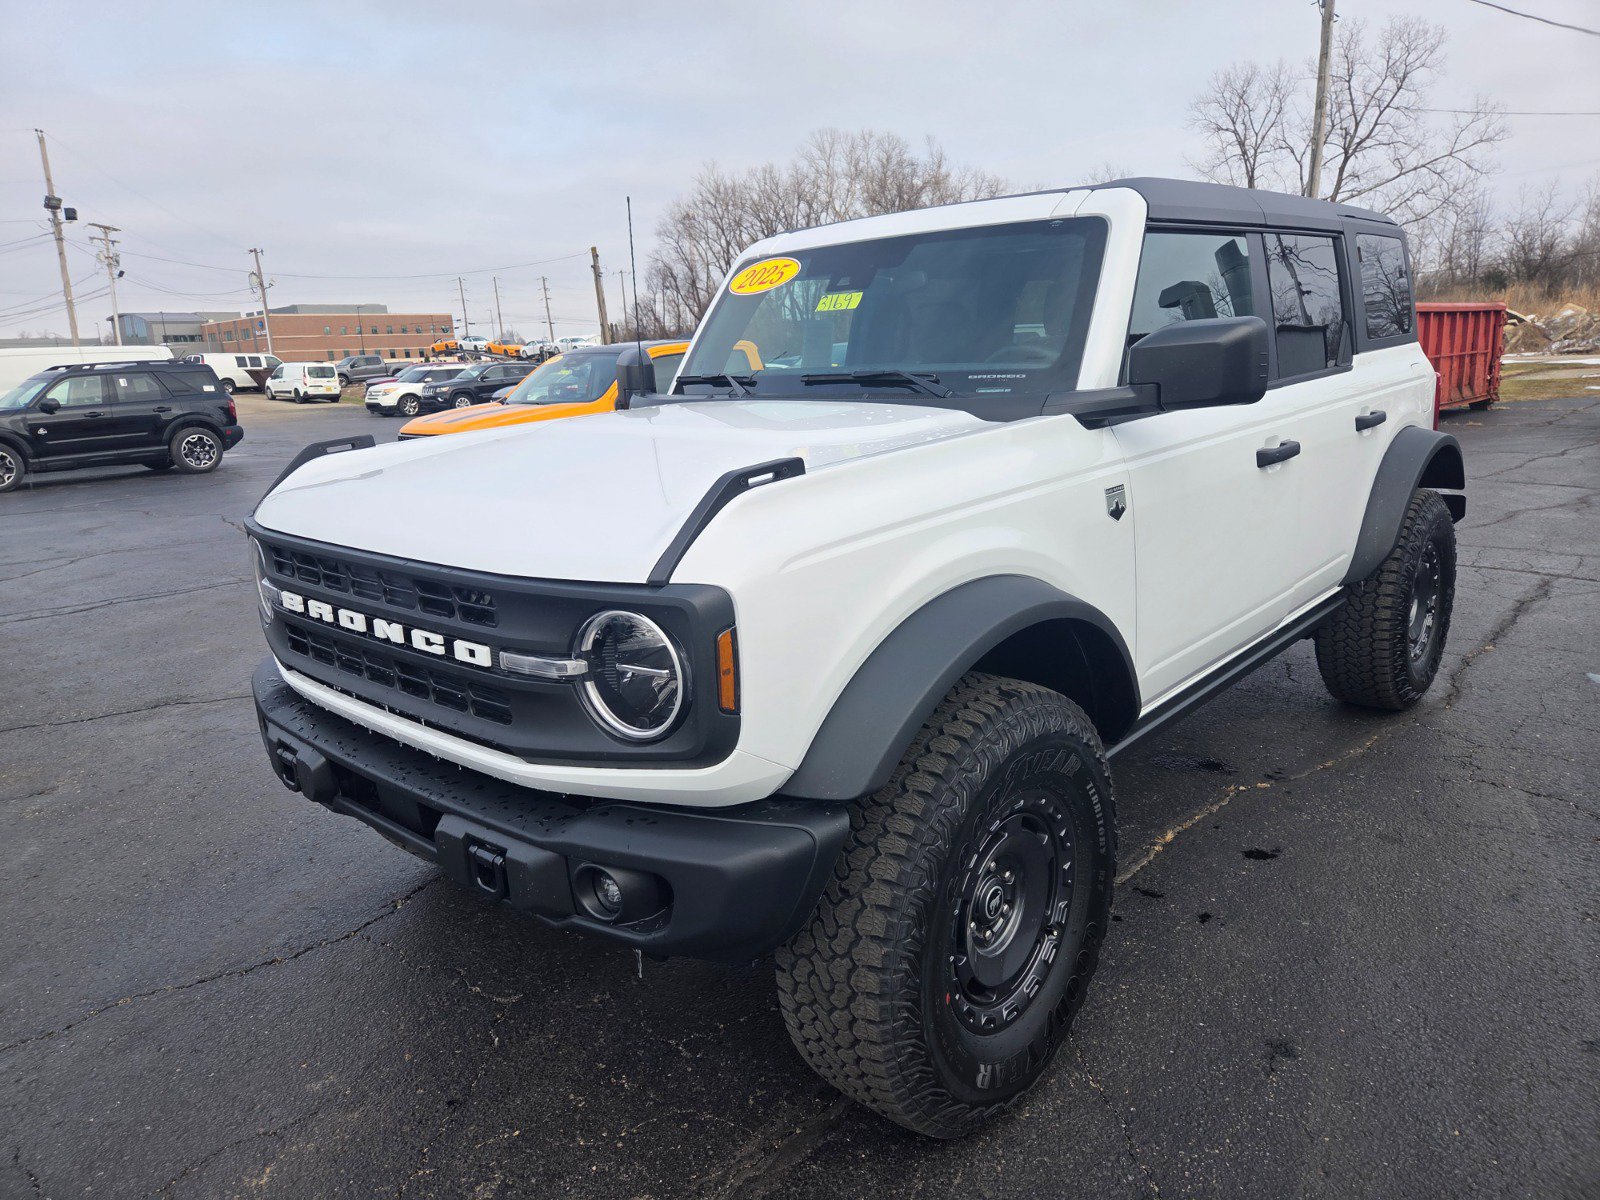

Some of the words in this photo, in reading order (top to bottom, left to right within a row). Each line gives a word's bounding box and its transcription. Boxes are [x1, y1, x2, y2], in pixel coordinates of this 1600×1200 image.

[736, 262, 793, 290] 2025
[820, 293, 853, 311] 3169
[281, 591, 492, 668] BRONCO
